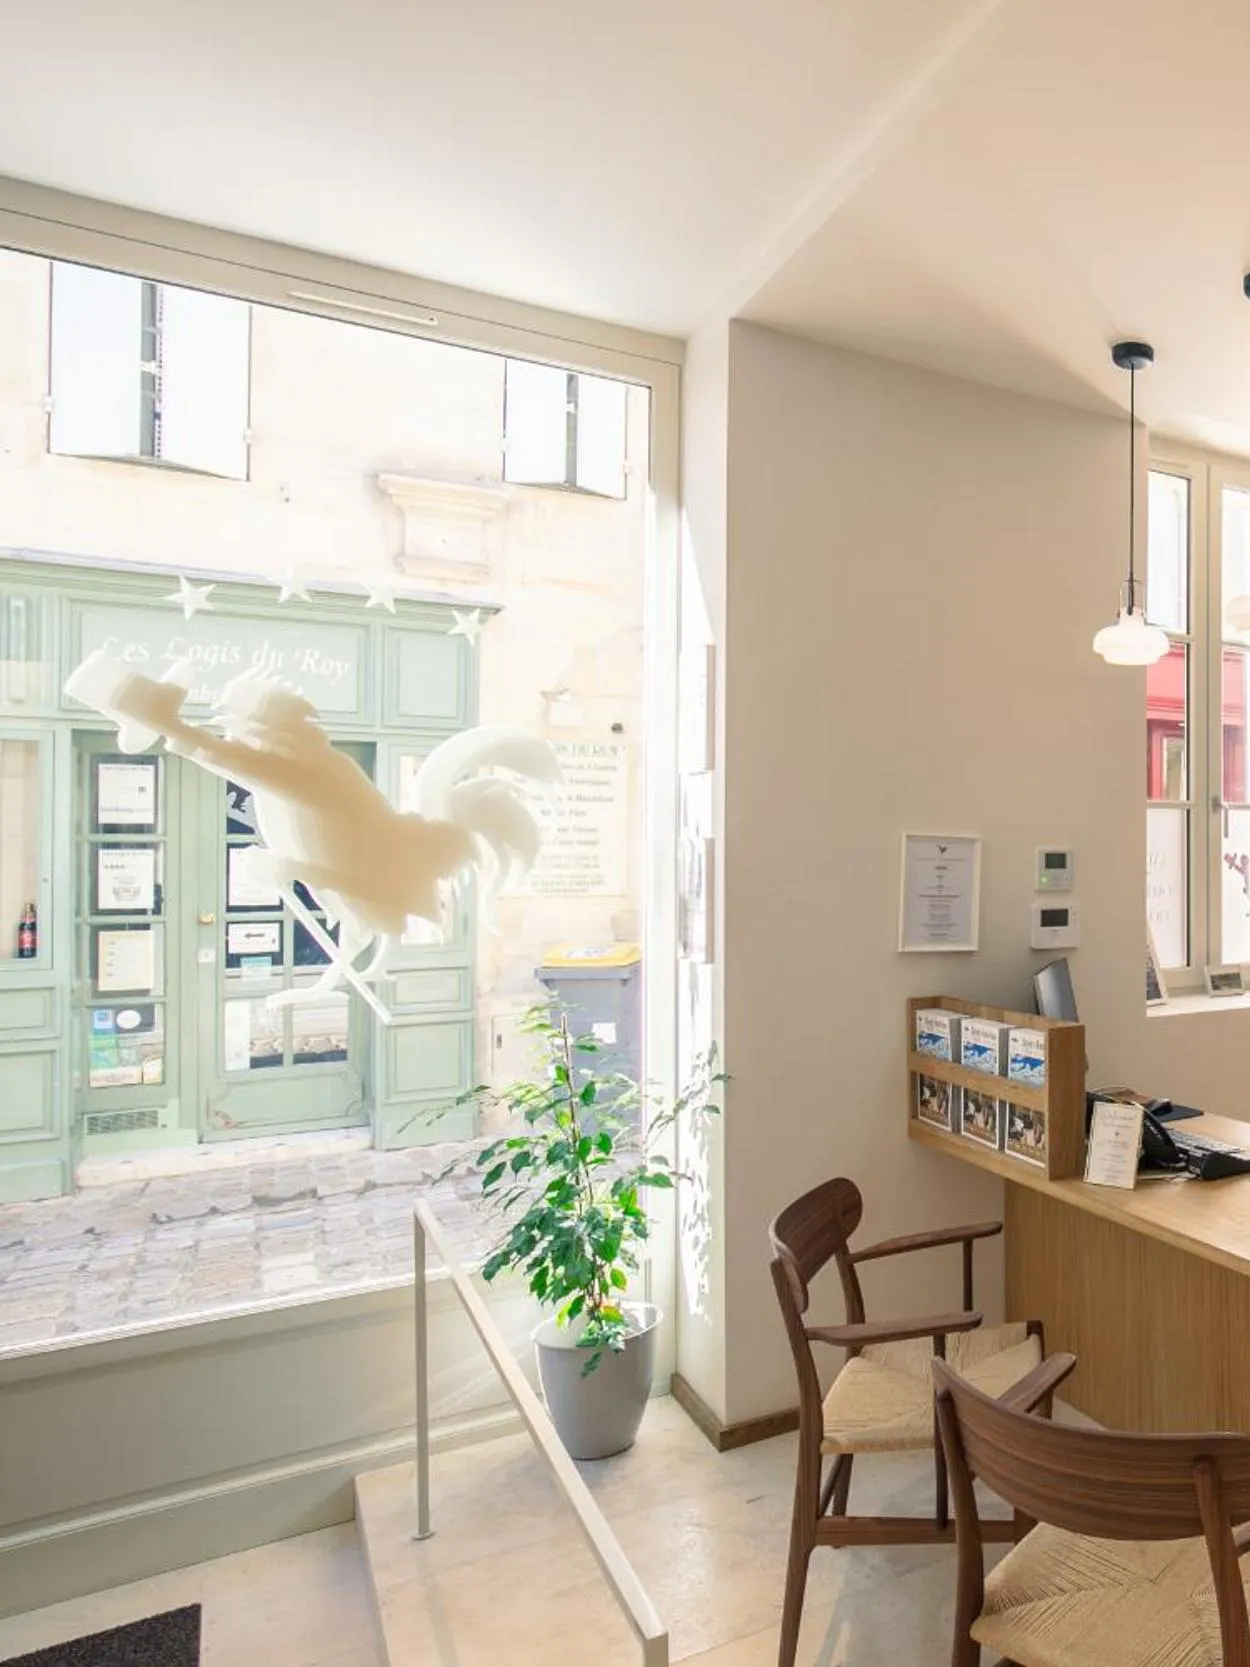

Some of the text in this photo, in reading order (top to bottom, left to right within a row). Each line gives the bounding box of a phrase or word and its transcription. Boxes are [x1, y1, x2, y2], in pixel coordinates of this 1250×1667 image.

[101, 637, 349, 686] Les Logis du Roy
